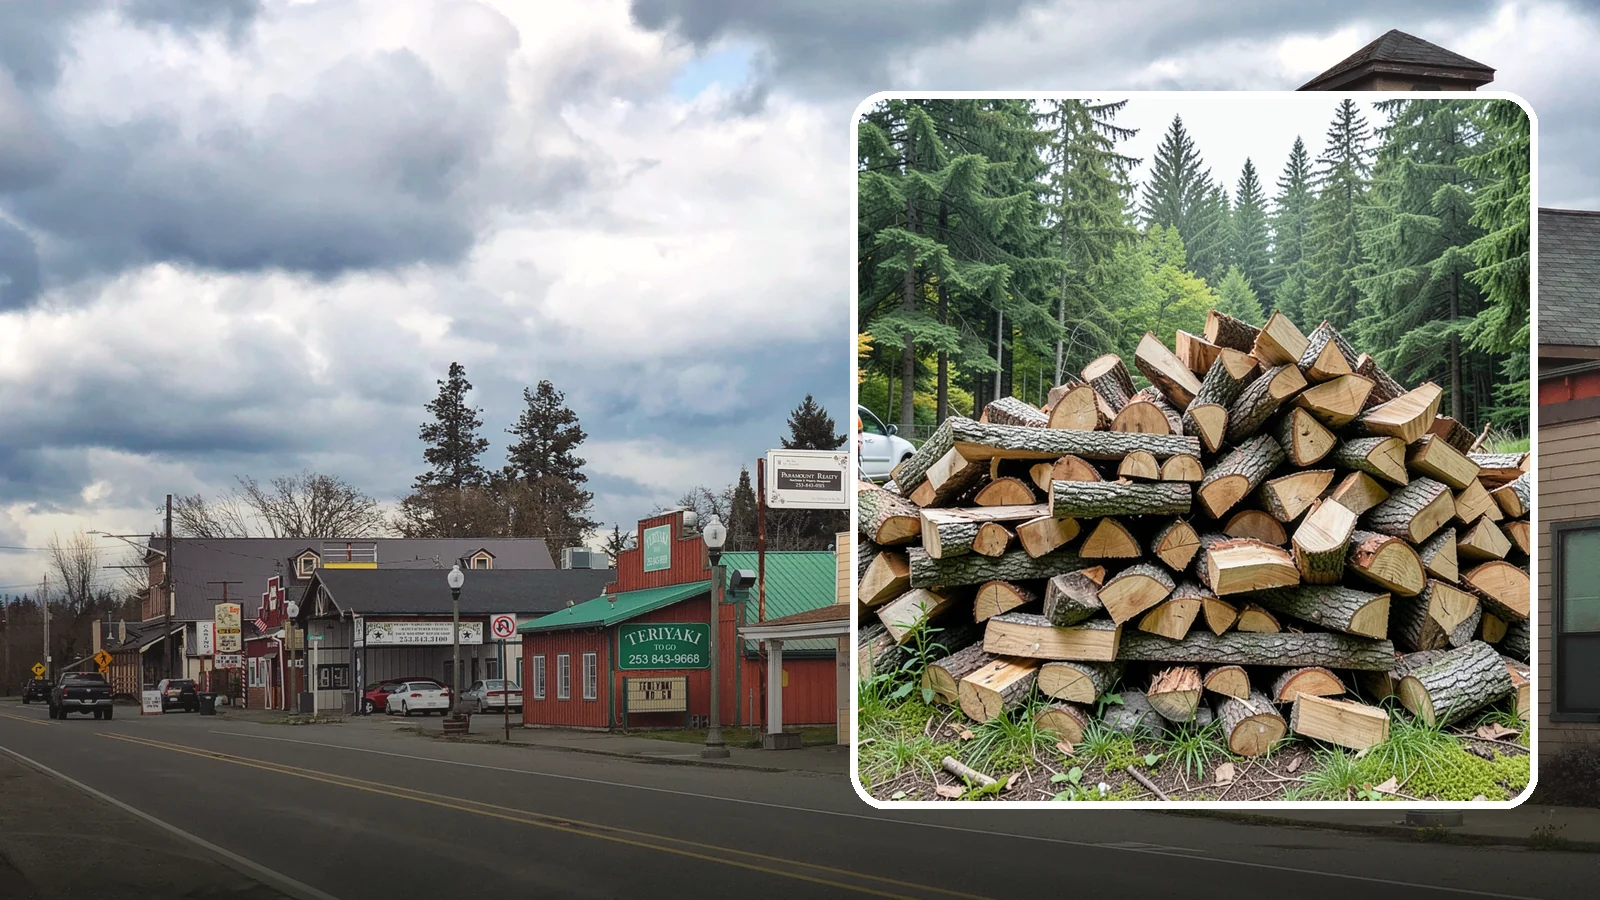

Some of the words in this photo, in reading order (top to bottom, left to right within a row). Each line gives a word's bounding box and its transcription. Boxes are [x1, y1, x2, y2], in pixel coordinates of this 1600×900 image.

[781, 471, 815, 479] PARAMOUNT
[817, 472, 839, 480] REALTY
[624, 627, 702, 646] TERIYAKI
[628, 654, 649, 665] 253
[651, 653, 700, 664] 843-9668
[639, 681, 673, 690] TERIYAKI
